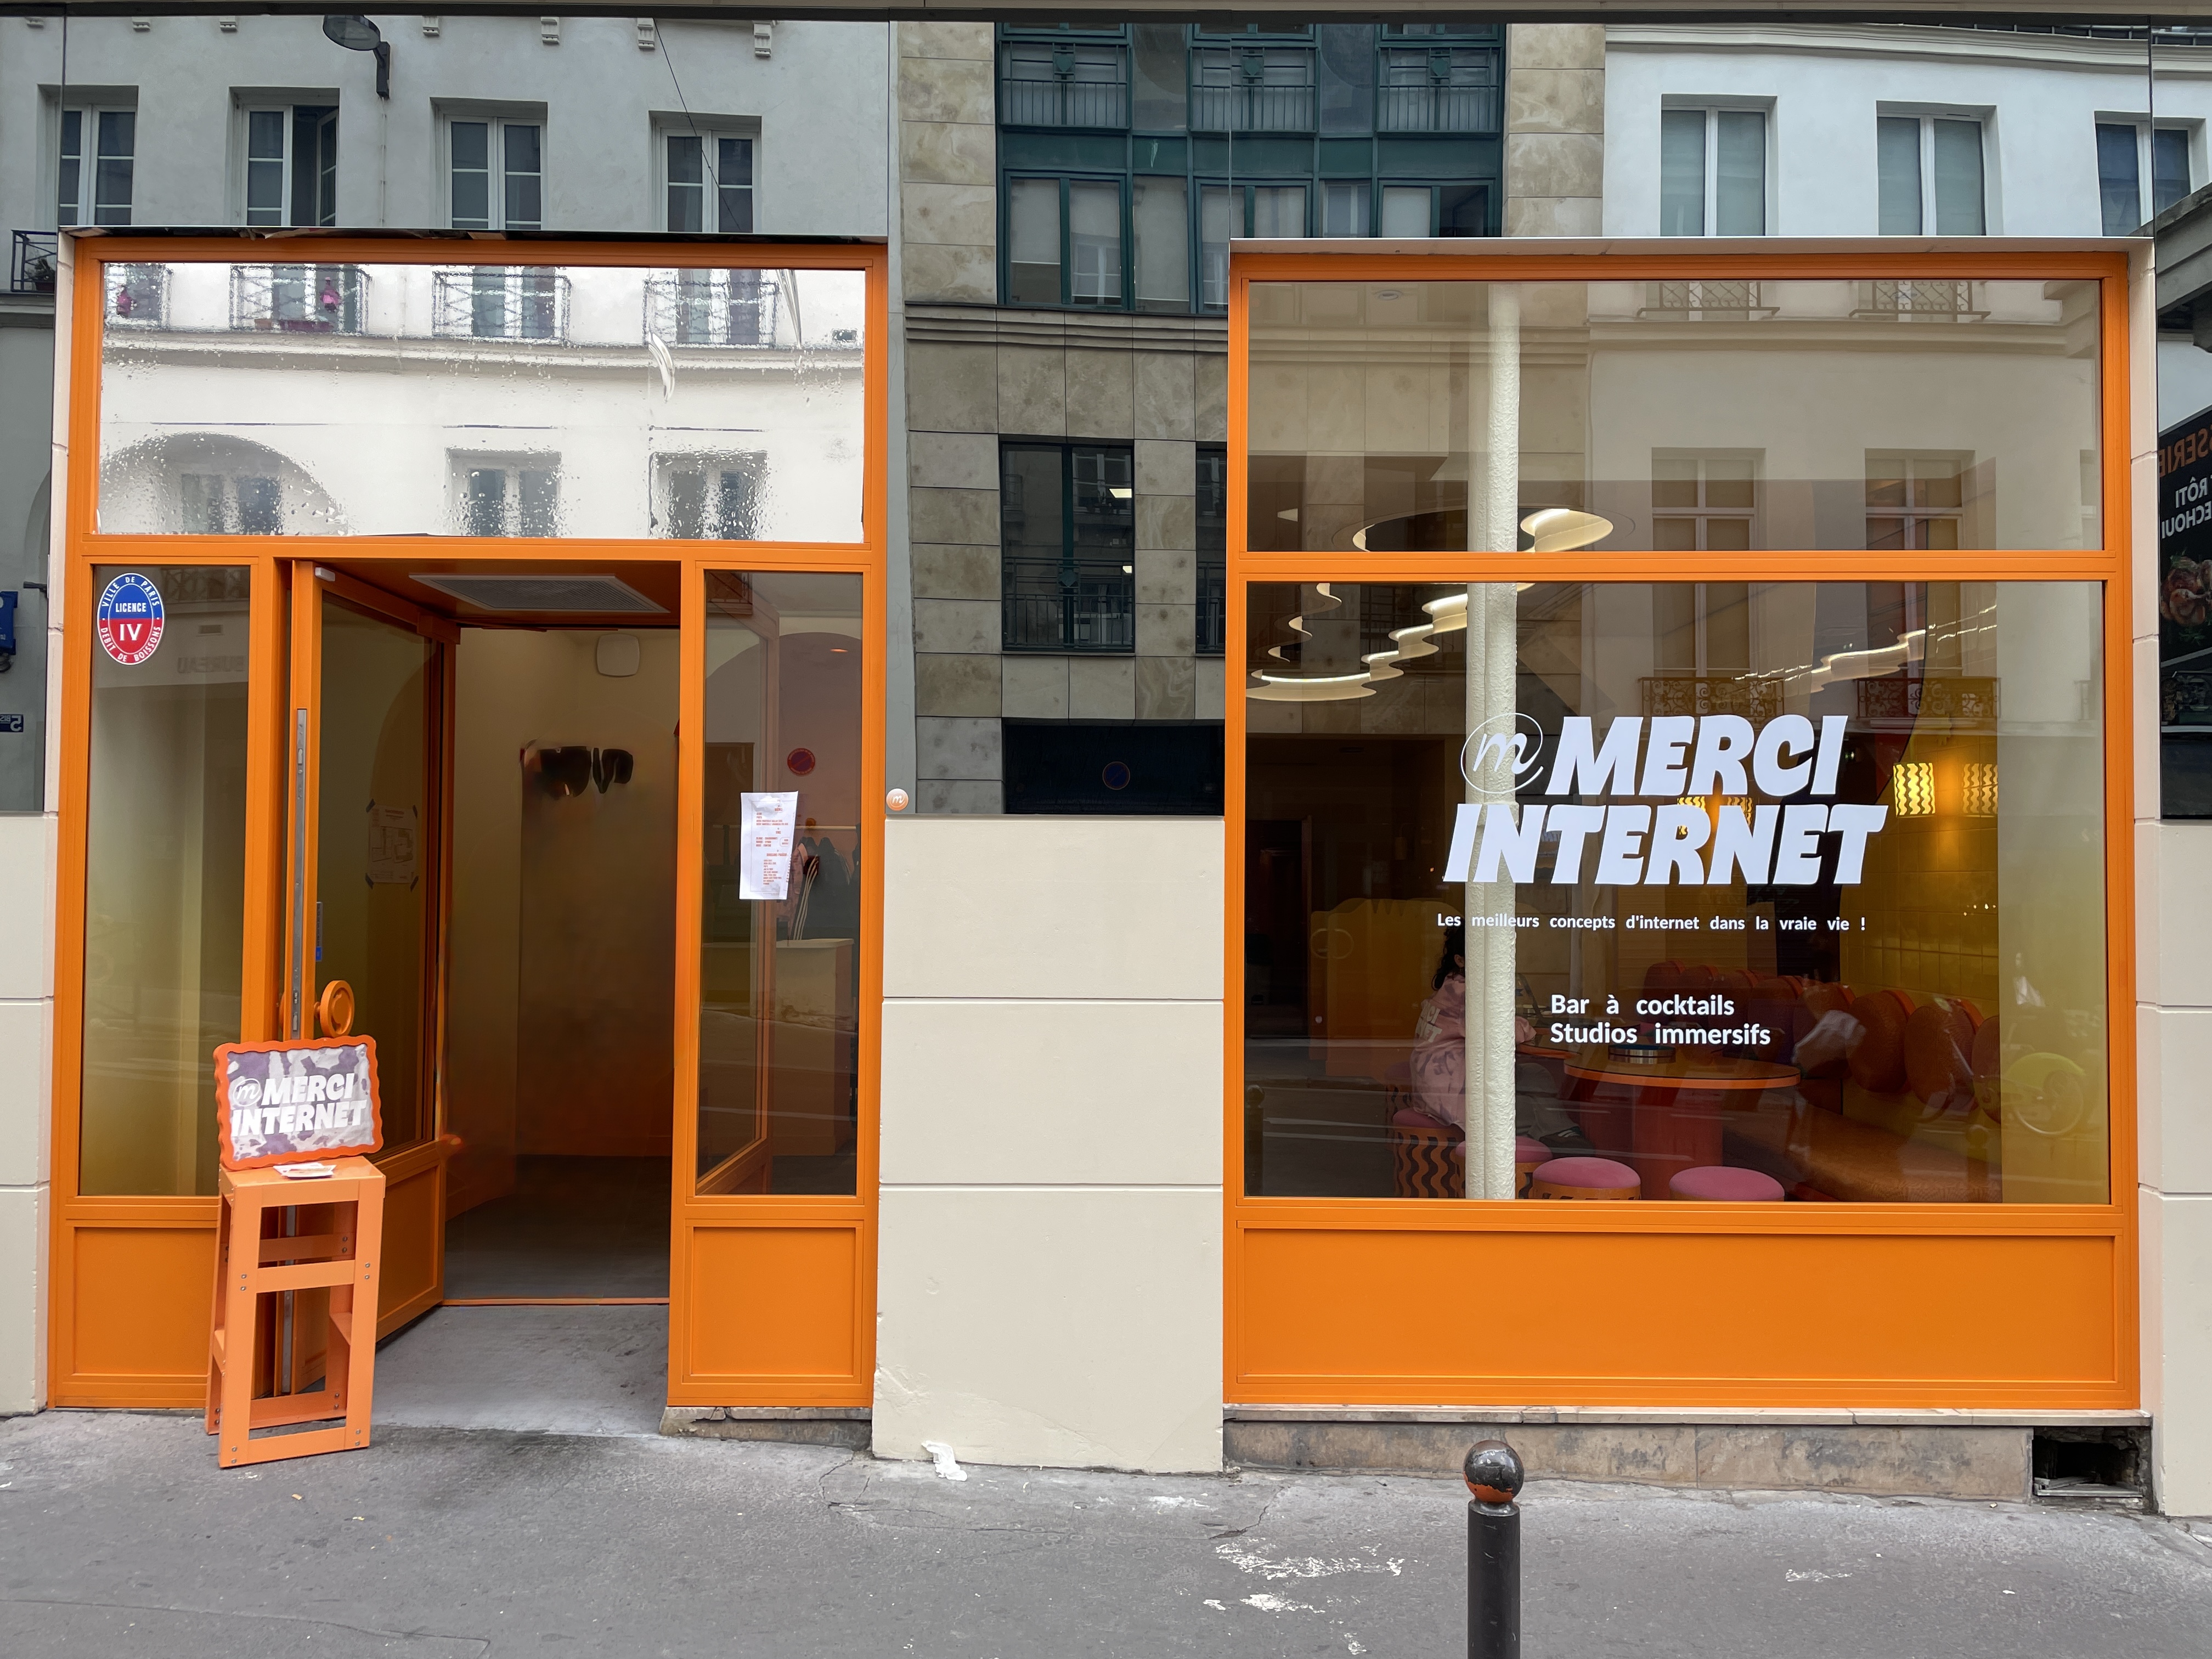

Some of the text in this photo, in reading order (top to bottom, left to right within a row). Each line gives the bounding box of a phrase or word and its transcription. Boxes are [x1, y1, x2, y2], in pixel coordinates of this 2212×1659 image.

[101, 582, 120, 607] VILLE
[140, 580, 160, 606] PARIS
[115, 602, 147, 613] LICENCE
[101, 627, 161, 662] DEBIT DE BOISSONS
[120, 623, 142, 641] IV
[1545, 715, 1848, 795] MERCI
[1442, 803, 1888, 885] INTERNET
[1437, 913, 1865, 931] Les meilleurs concepts d'internet dans la vraie vie !
[1551, 994, 1735, 1015] Bar à cocktails
[1550, 1022, 1771, 1045] Studios immersifs
[261, 1073, 356, 1106] MERCI
[231, 1099, 367, 1137] INTERNET
